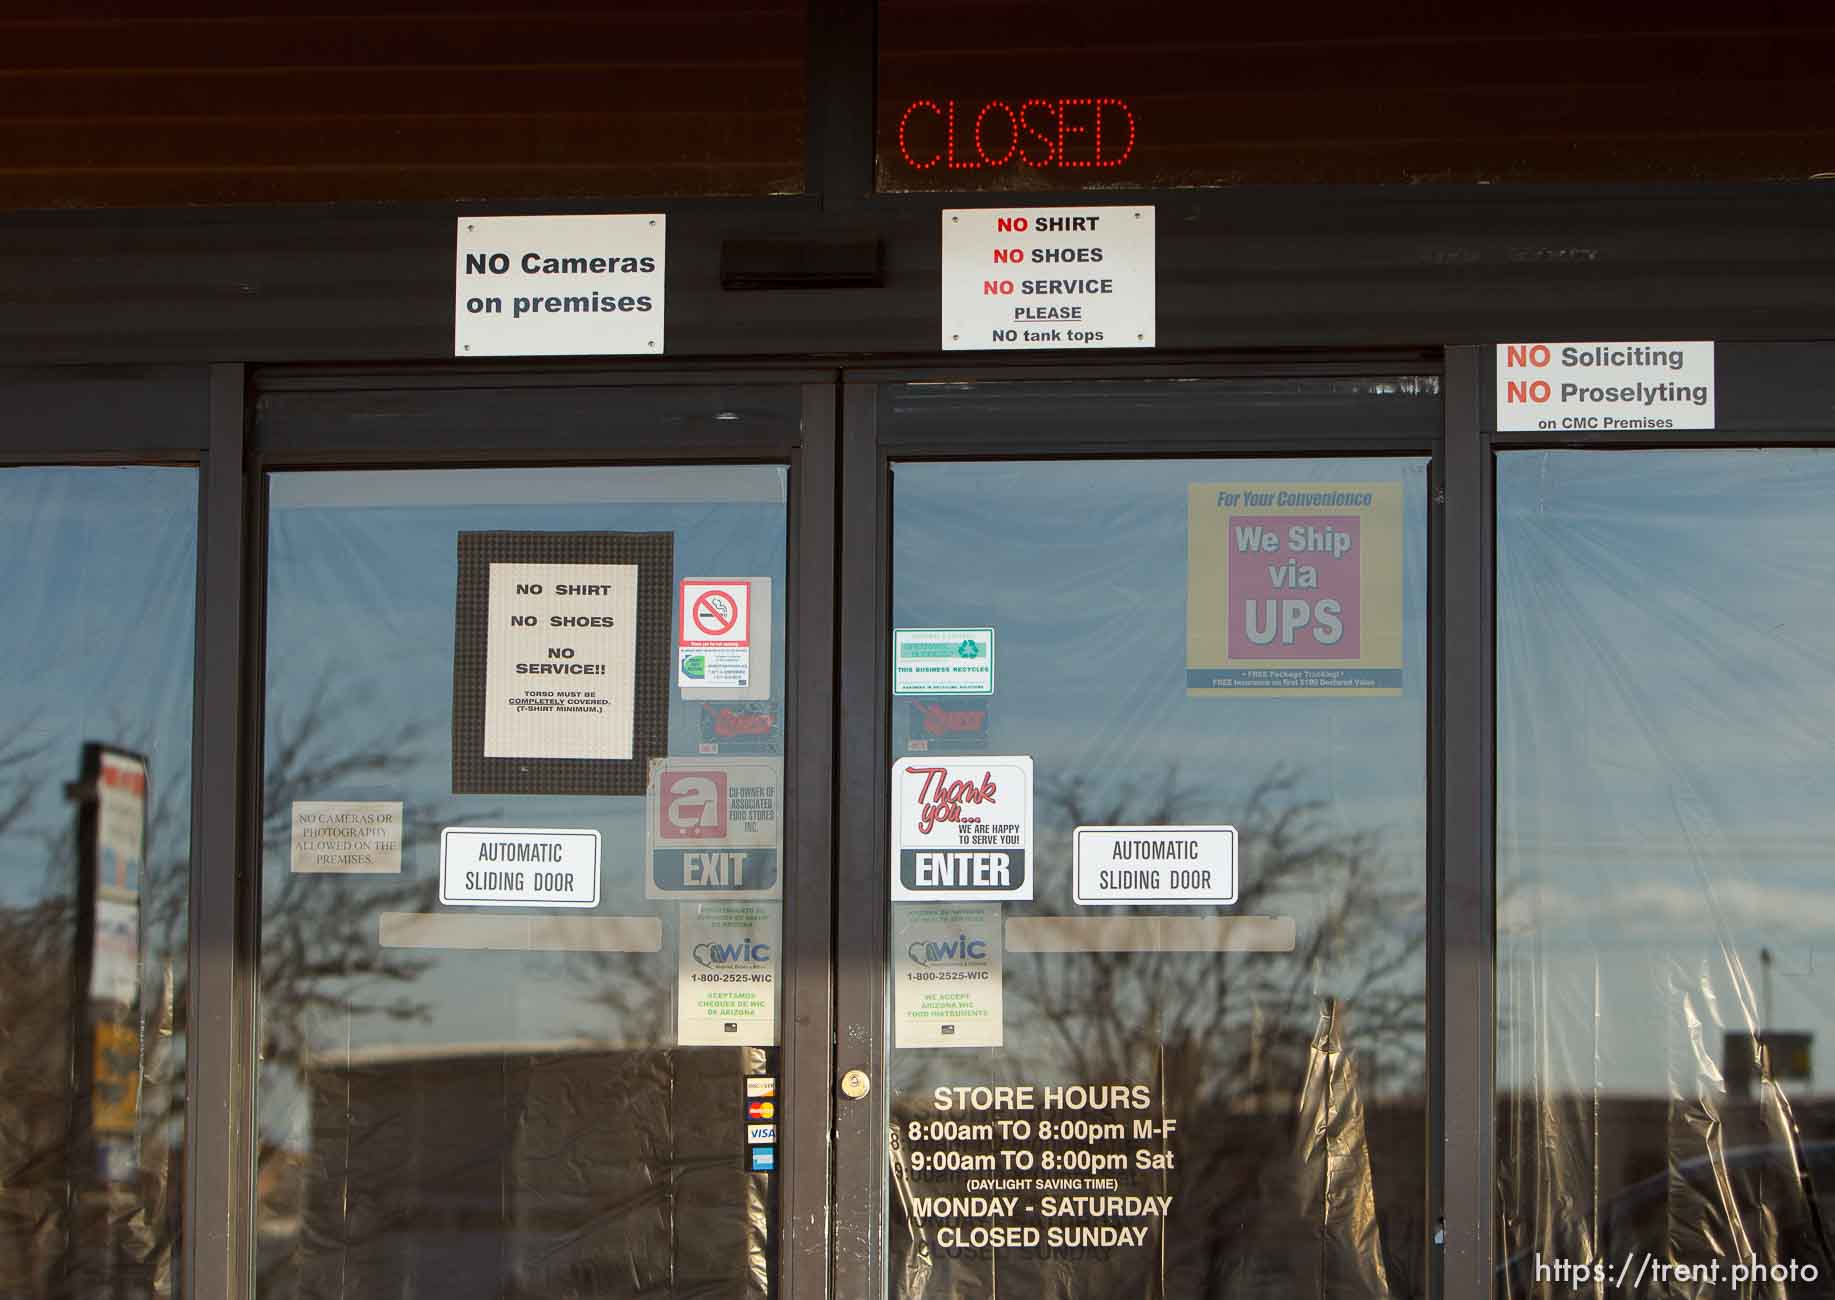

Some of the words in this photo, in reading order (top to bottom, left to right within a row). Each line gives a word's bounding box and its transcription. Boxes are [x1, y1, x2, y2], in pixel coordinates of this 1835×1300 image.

[899, 98, 1135, 169] CLOSED
[997, 217, 1028, 232] NO
[1035, 216, 1100, 232] SHIRT
[465, 253, 510, 274] NO
[521, 252, 656, 274] Cameras
[993, 249, 1024, 263] NO
[1031, 247, 1104, 263] SHOES
[983, 280, 1014, 295] NO
[1021, 279, 1113, 295] SERVICE
[466, 294, 502, 313] on
[513, 291, 653, 318] premises
[1013, 306, 1082, 320] PLEASE
[992, 330, 1018, 342] NO
[1023, 329, 1061, 342] tank
[1067, 330, 1104, 344] tops
[1507, 345, 1551, 368] NO
[1561, 347, 1684, 369] Soliciting
[1507, 381, 1551, 403] NO
[1561, 382, 1707, 406] Proselyting
[1538, 420, 1557, 430] on
[1562, 417, 1598, 429] CMC
[1604, 416, 1673, 429] Premises
[1217, 491, 1240, 507] For
[1243, 491, 1275, 507] Your
[1278, 491, 1373, 507] Convenience
[1235, 526, 1280, 552] We
[1288, 526, 1351, 558] Ship
[1268, 559, 1318, 589] via
[516, 584, 543, 596] NO
[555, 584, 612, 596] SHIRT
[511, 616, 538, 627] NO
[550, 616, 614, 628] SHOES
[1245, 599, 1343, 645] UPS
[548, 648, 575, 659] NO
[515, 663, 606, 675] SERVICE!!
[905, 767, 997, 804] Thank
[731, 799, 773, 809] ASSOCIATED
[299, 815, 316, 824] NO
[318, 814, 372, 824] CAMERAS
[375, 814, 393, 824] OR
[303, 827, 386, 837] PHOTOGRAPHY
[959, 824, 972, 834] WE
[974, 824, 990, 834] ARE
[992, 824, 1020, 834] HAPPY
[296, 840, 352, 850] ALLOWED
[354, 841, 370, 850] ON
[375, 841, 399, 850] THE
[959, 835, 970, 845] TO
[972, 835, 998, 845] SERVE
[1000, 835, 1020, 845] YOU!
[479, 842, 562, 863] AUTOMATIC
[1112, 840, 1198, 860] AUTOMATIC
[683, 853, 747, 886] EXIT
[915, 852, 1010, 886] ENTER
[465, 871, 524, 891] SLIDING
[533, 872, 574, 892] DOOR
[1099, 870, 1160, 889] SLIDING
[1170, 870, 1211, 889] DOOR
[691, 973, 772, 983] 1-800-2525-WIC
[907, 971, 989, 981] 1-800-2525-WIC
[934, 1087, 1034, 1111] STORE
[1044, 1086, 1150, 1110] HOURS
[751, 1129, 776, 1138] VISA
[908, 1121, 992, 1141] 8:00am
[997, 1121, 1031, 1140] TO
[1038, 1120, 1124, 1144] 8:00pm
[1133, 1119, 1177, 1139] M-F
[911, 1151, 995, 1171] 9:00am
[1000, 1151, 1033, 1170] TO
[1041, 1150, 1127, 1174] 8:00pm
[1136, 1149, 1175, 1170] Sat
[966, 1179, 1032, 1192] (DAYLIGHT
[1036, 1179, 1082, 1190] SAVING
[1084, 1179, 1119, 1192] TIME)
[912, 1198, 1018, 1217] MONDAY
[1041, 1196, 1173, 1217] SATURDAY
[937, 1227, 1040, 1248] CLOSED
[1047, 1227, 1148, 1247] SUNDAY
